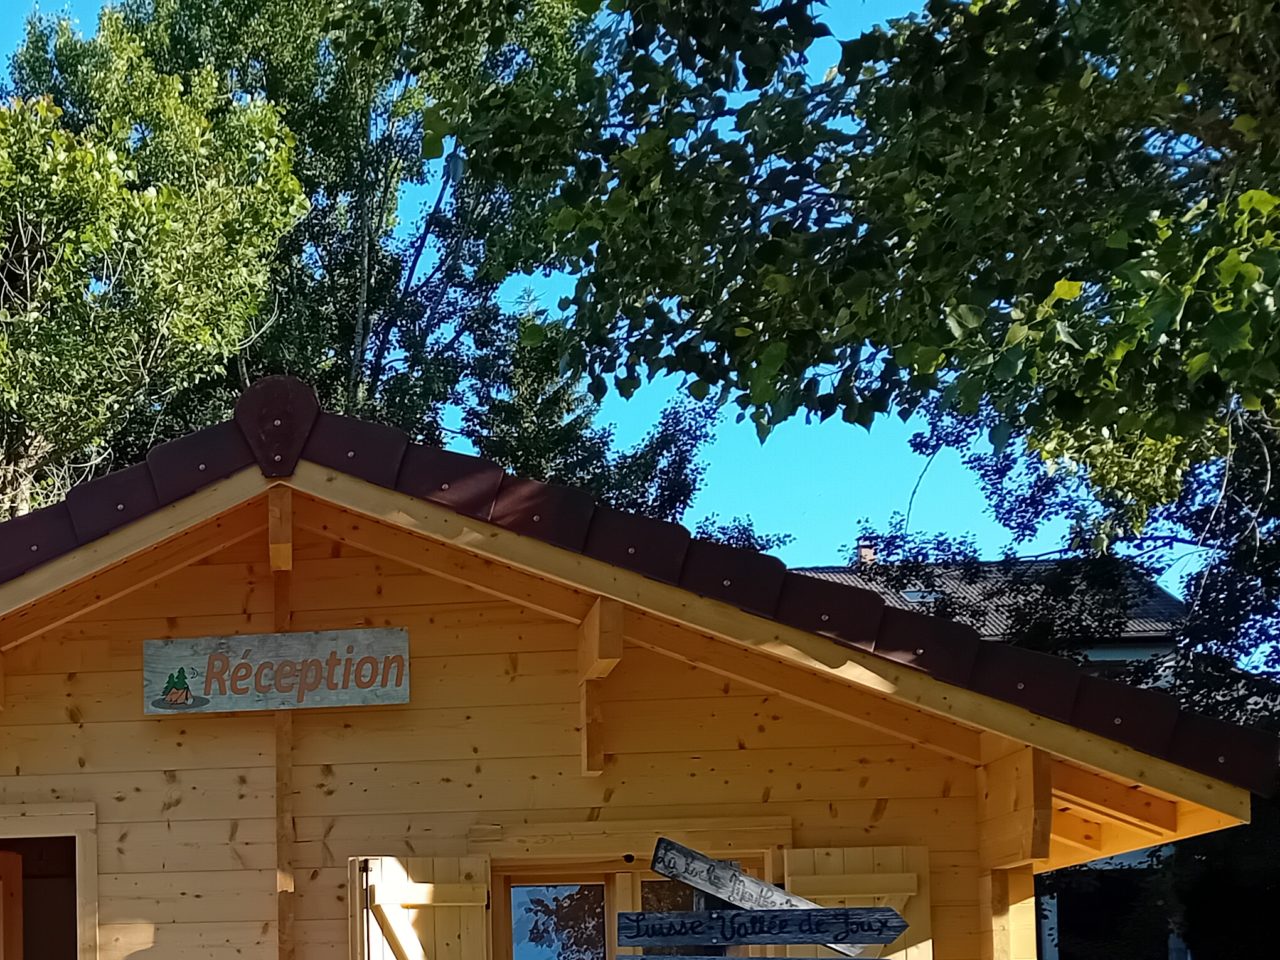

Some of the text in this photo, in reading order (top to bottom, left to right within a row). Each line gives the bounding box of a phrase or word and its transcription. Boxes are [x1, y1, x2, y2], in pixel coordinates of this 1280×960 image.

[203, 643, 405, 704] Réception
[718, 911, 791, 942] Vallée
[798, 912, 831, 935] de
[832, 911, 893, 941] Joux
